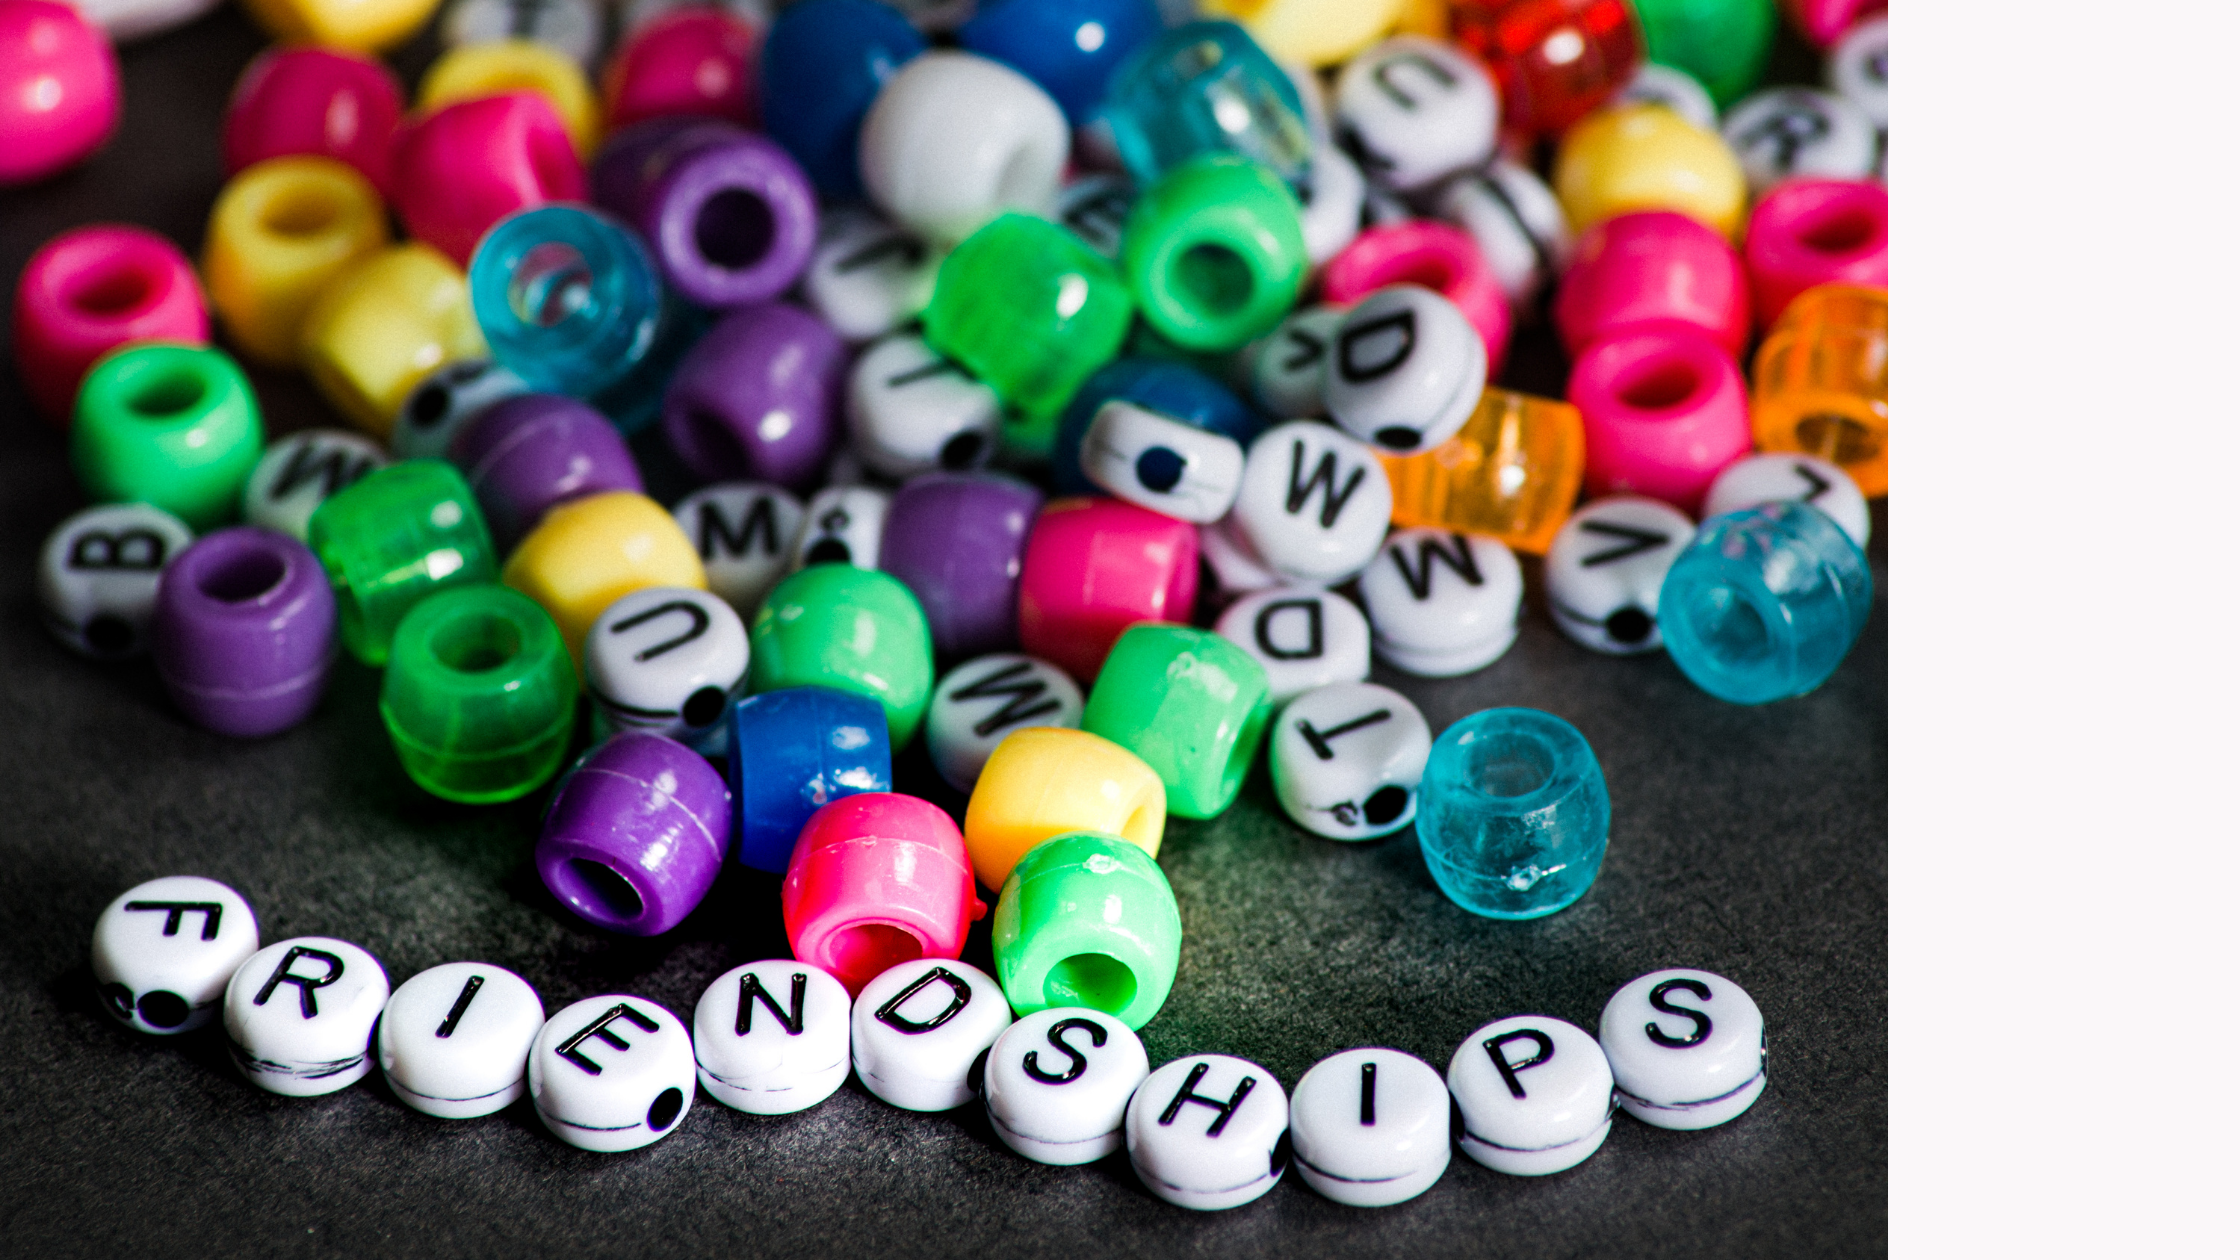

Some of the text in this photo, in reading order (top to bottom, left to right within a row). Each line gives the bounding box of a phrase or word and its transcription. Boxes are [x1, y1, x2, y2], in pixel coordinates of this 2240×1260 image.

[1337, 309, 1416, 384] D
[68, 528, 167, 572] B
[701, 495, 779, 559] M
[611, 601, 709, 661] U
[1254, 599, 1323, 660] D
[1299, 710, 1391, 760] T
